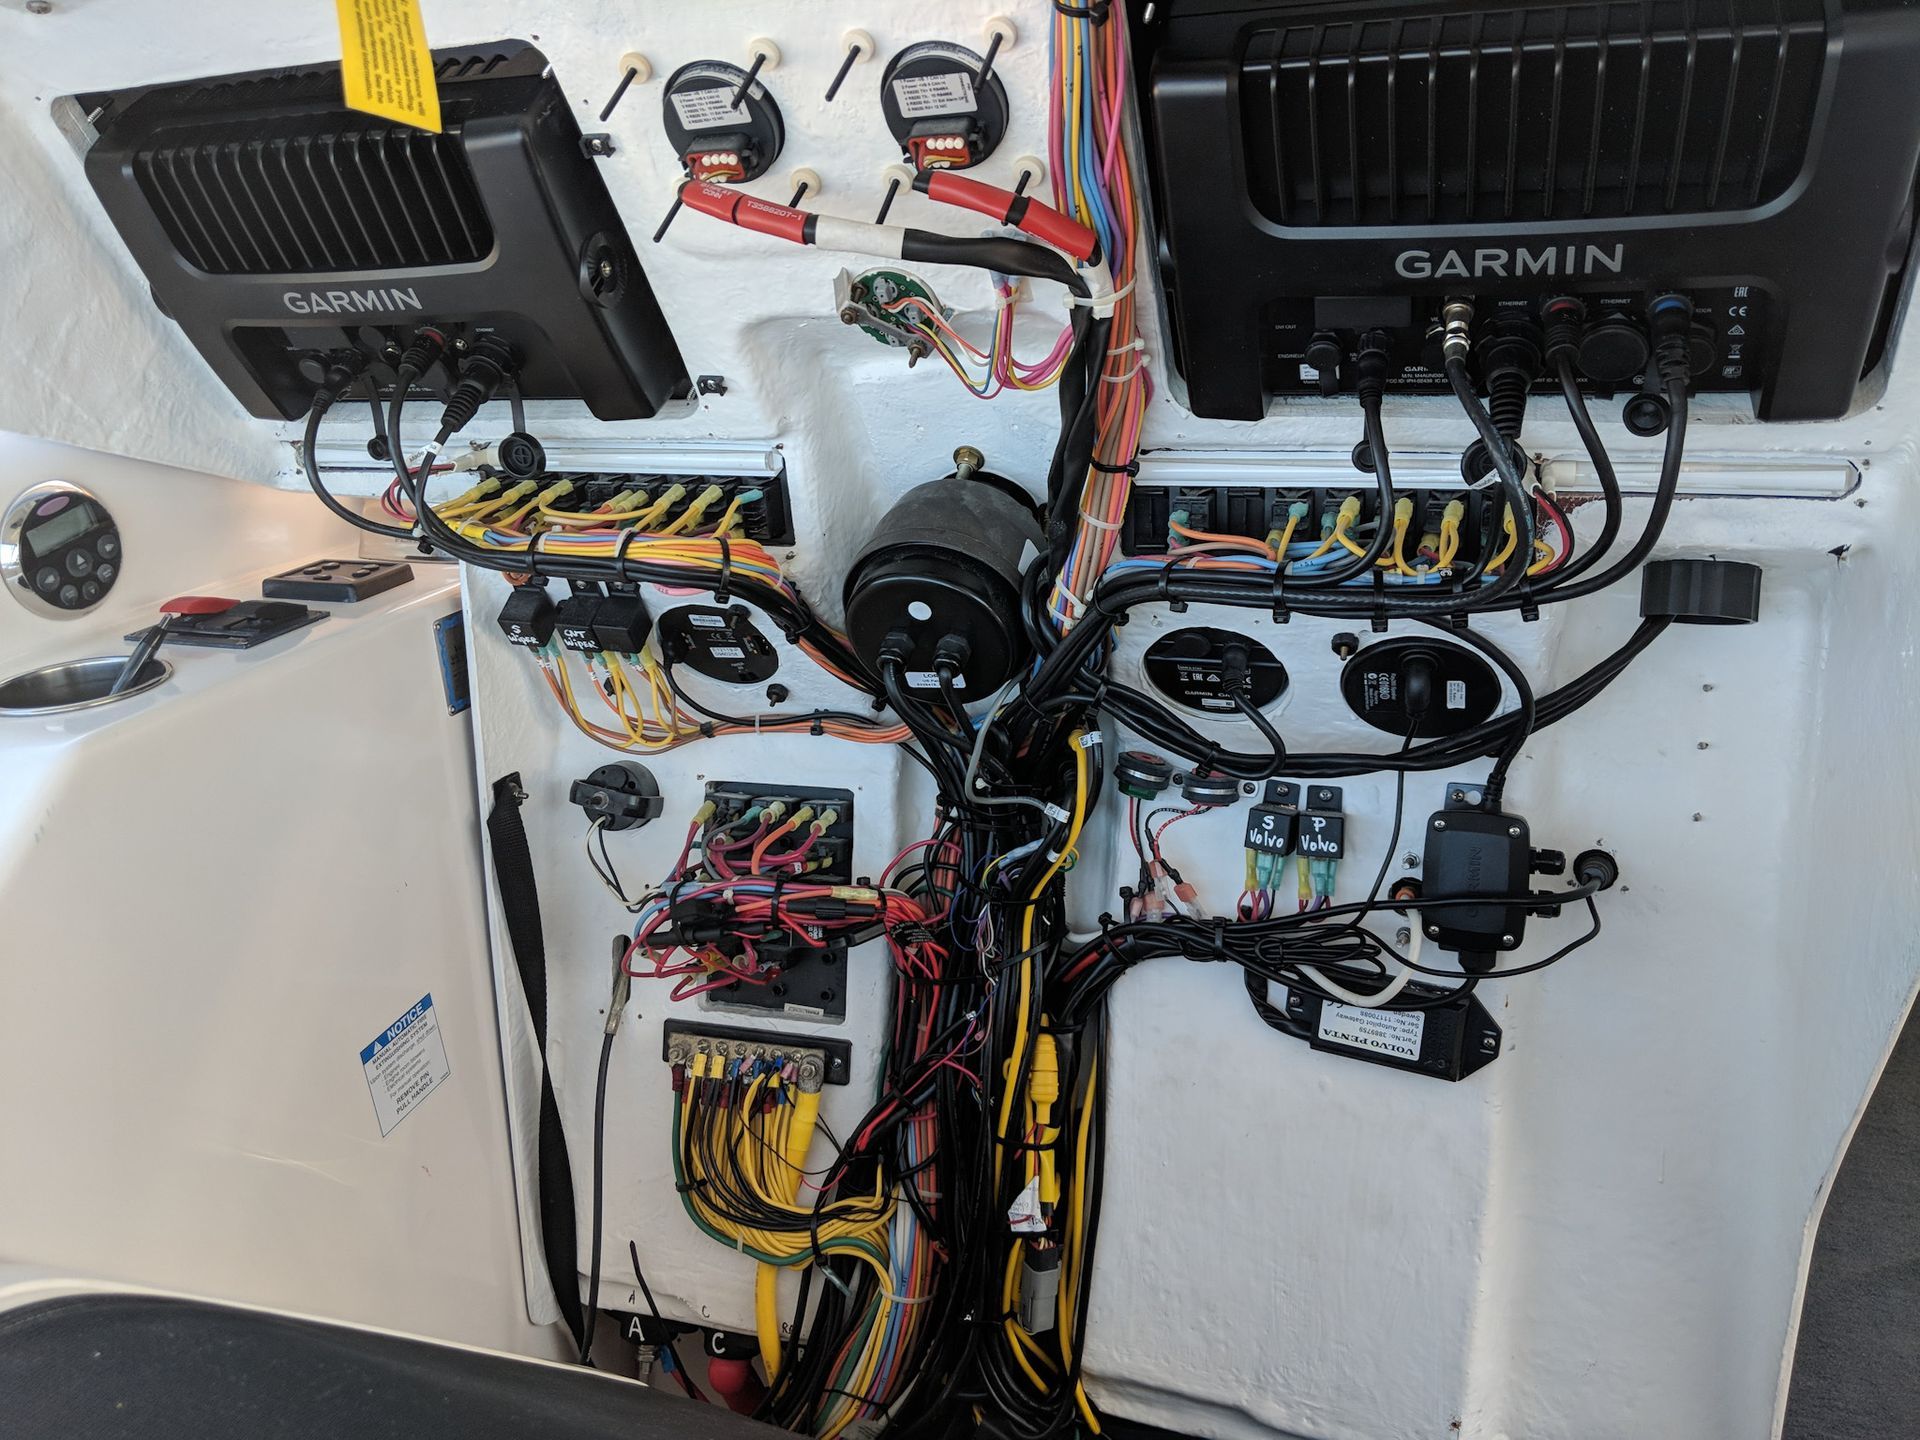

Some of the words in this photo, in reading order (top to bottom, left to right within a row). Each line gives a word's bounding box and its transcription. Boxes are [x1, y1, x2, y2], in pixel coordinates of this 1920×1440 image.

[1395, 243, 1624, 279] GARMIN
[283, 288, 423, 314] GARMIN
[511, 624, 522, 634] S
[1262, 815, 1275, 830] S
[1311, 817, 1326, 832] P
[1250, 828, 1284, 848] Volvo
[1301, 834, 1338, 853] Volvo
[386, 1003, 424, 1042] NOTICE
[1335, 1012, 1365, 1025] Gateway
[1393, 1011, 1421, 1022] Sweden
[1323, 1027, 1368, 1045] PENTA
[1365, 1020, 1398, 1033] Autopilot
[1399, 1027, 1418, 1038] Type:
[372, 1047, 392, 1064] MANUAL
[392, 1023, 418, 1048] AUTOMATIC
[375, 1039, 410, 1071] EXTINGUISHING
[410, 1022, 428, 1039] SYSTEM
[1371, 1039, 1416, 1057] VOLVO
[396, 1080, 420, 1105] REMOVE
[419, 1071, 430, 1084] PIN
[396, 1099, 412, 1116] PULL
[411, 1077, 434, 1101] HANDLE
[628, 1316, 646, 1342] A
[712, 1332, 726, 1354] C
